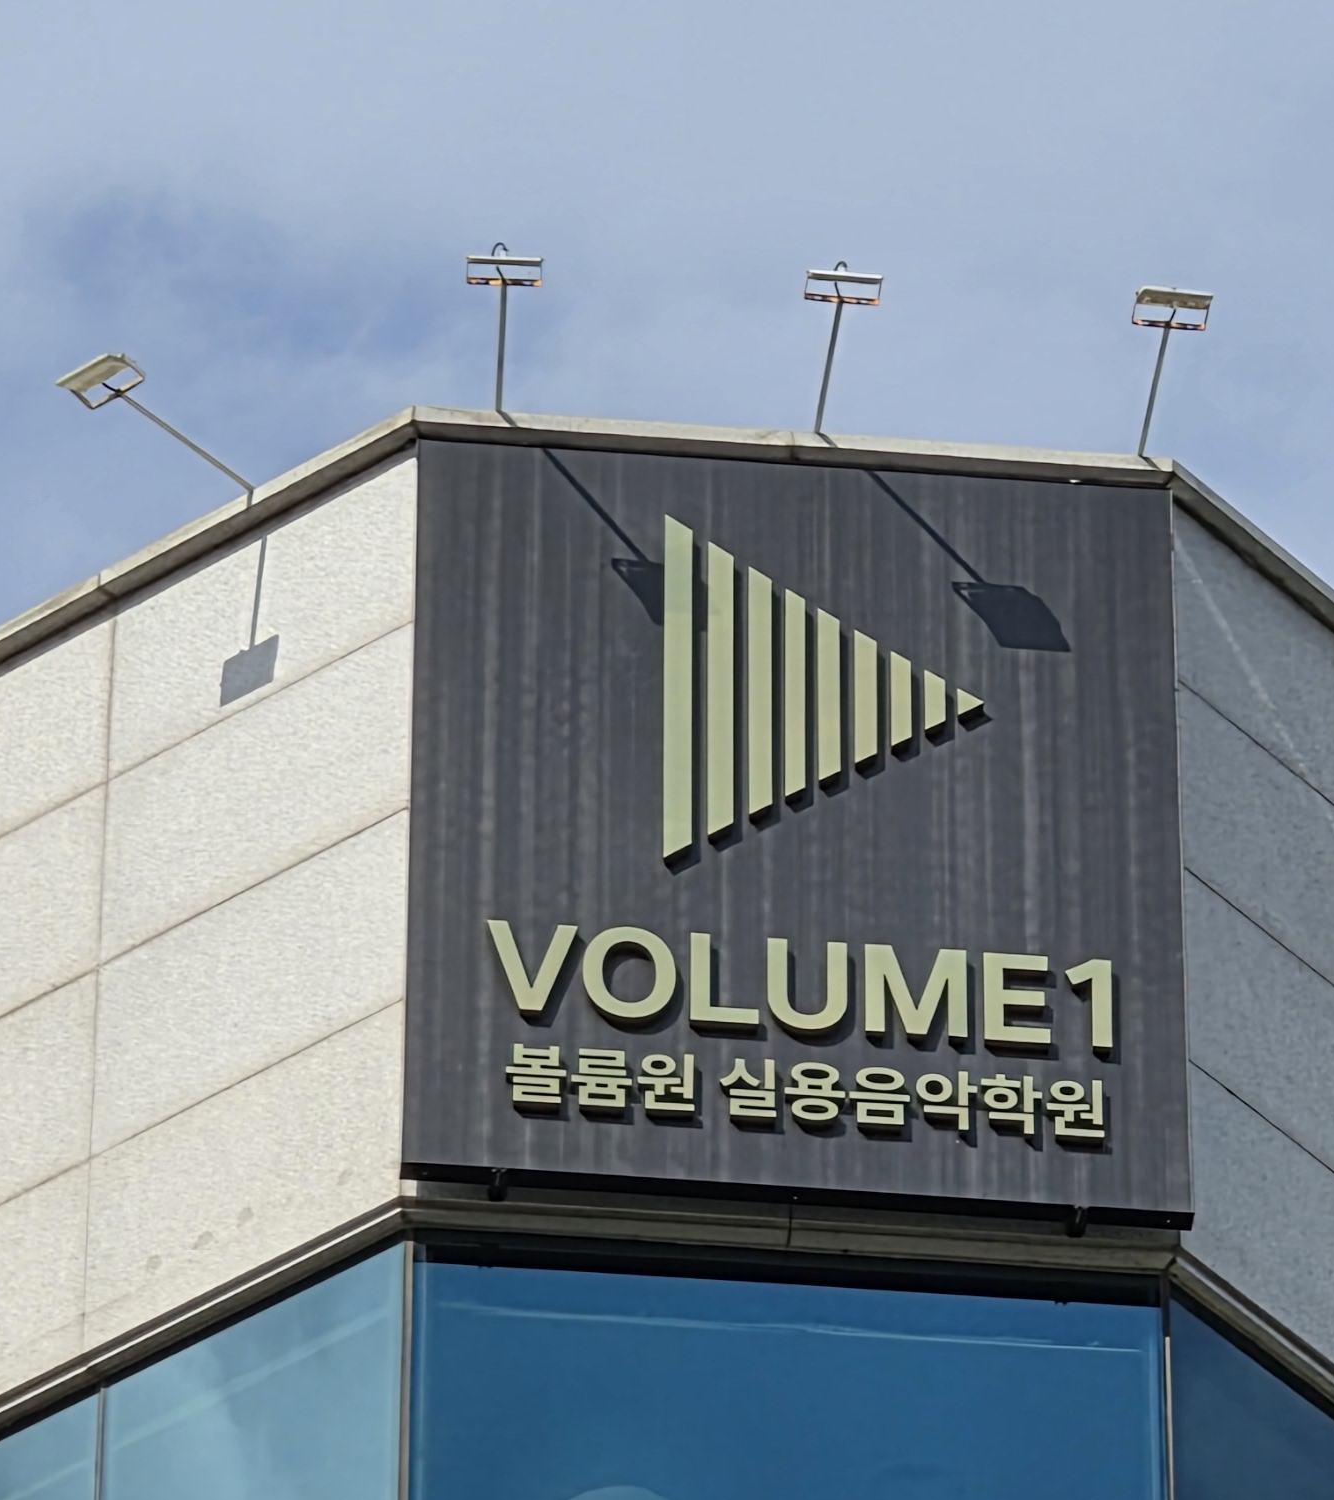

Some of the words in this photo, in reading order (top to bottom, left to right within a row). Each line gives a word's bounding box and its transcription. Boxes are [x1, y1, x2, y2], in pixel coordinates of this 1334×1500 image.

[487, 918, 1114, 1050] VOLUME1
[505, 1043, 696, 1113] 볼륨원
[719, 1056, 1106, 1139] 실용음악학원
